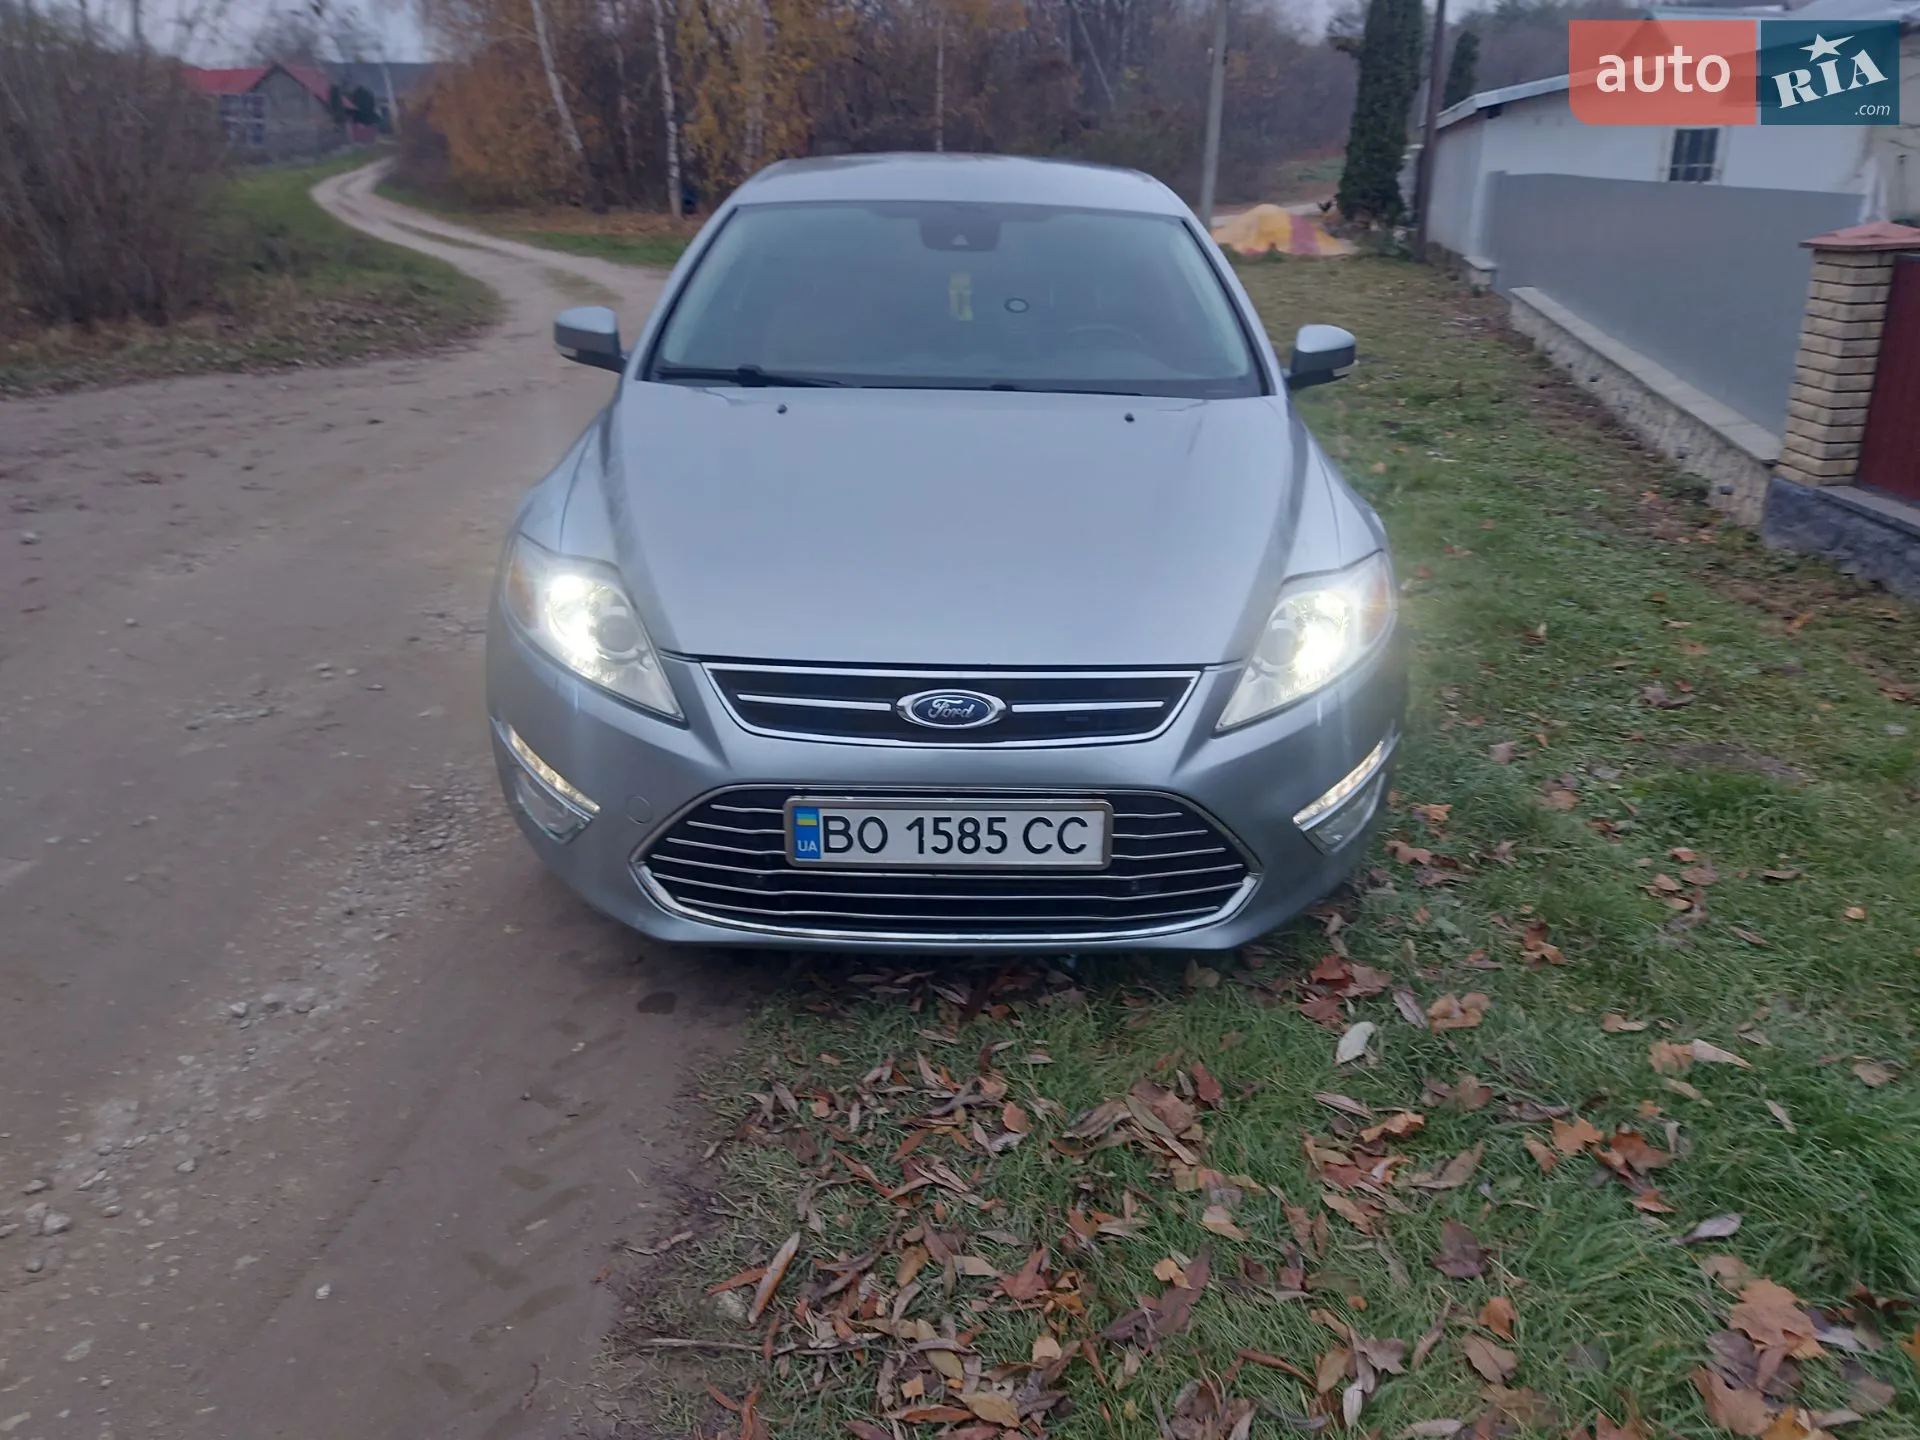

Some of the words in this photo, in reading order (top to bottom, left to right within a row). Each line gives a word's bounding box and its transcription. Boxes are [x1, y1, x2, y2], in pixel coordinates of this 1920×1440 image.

[927, 698, 976, 719] Ford
[822, 815, 888, 854] BO
[905, 816, 1008, 855] 1585
[1022, 816, 1089, 855] CC
[797, 840, 818, 853] UA
